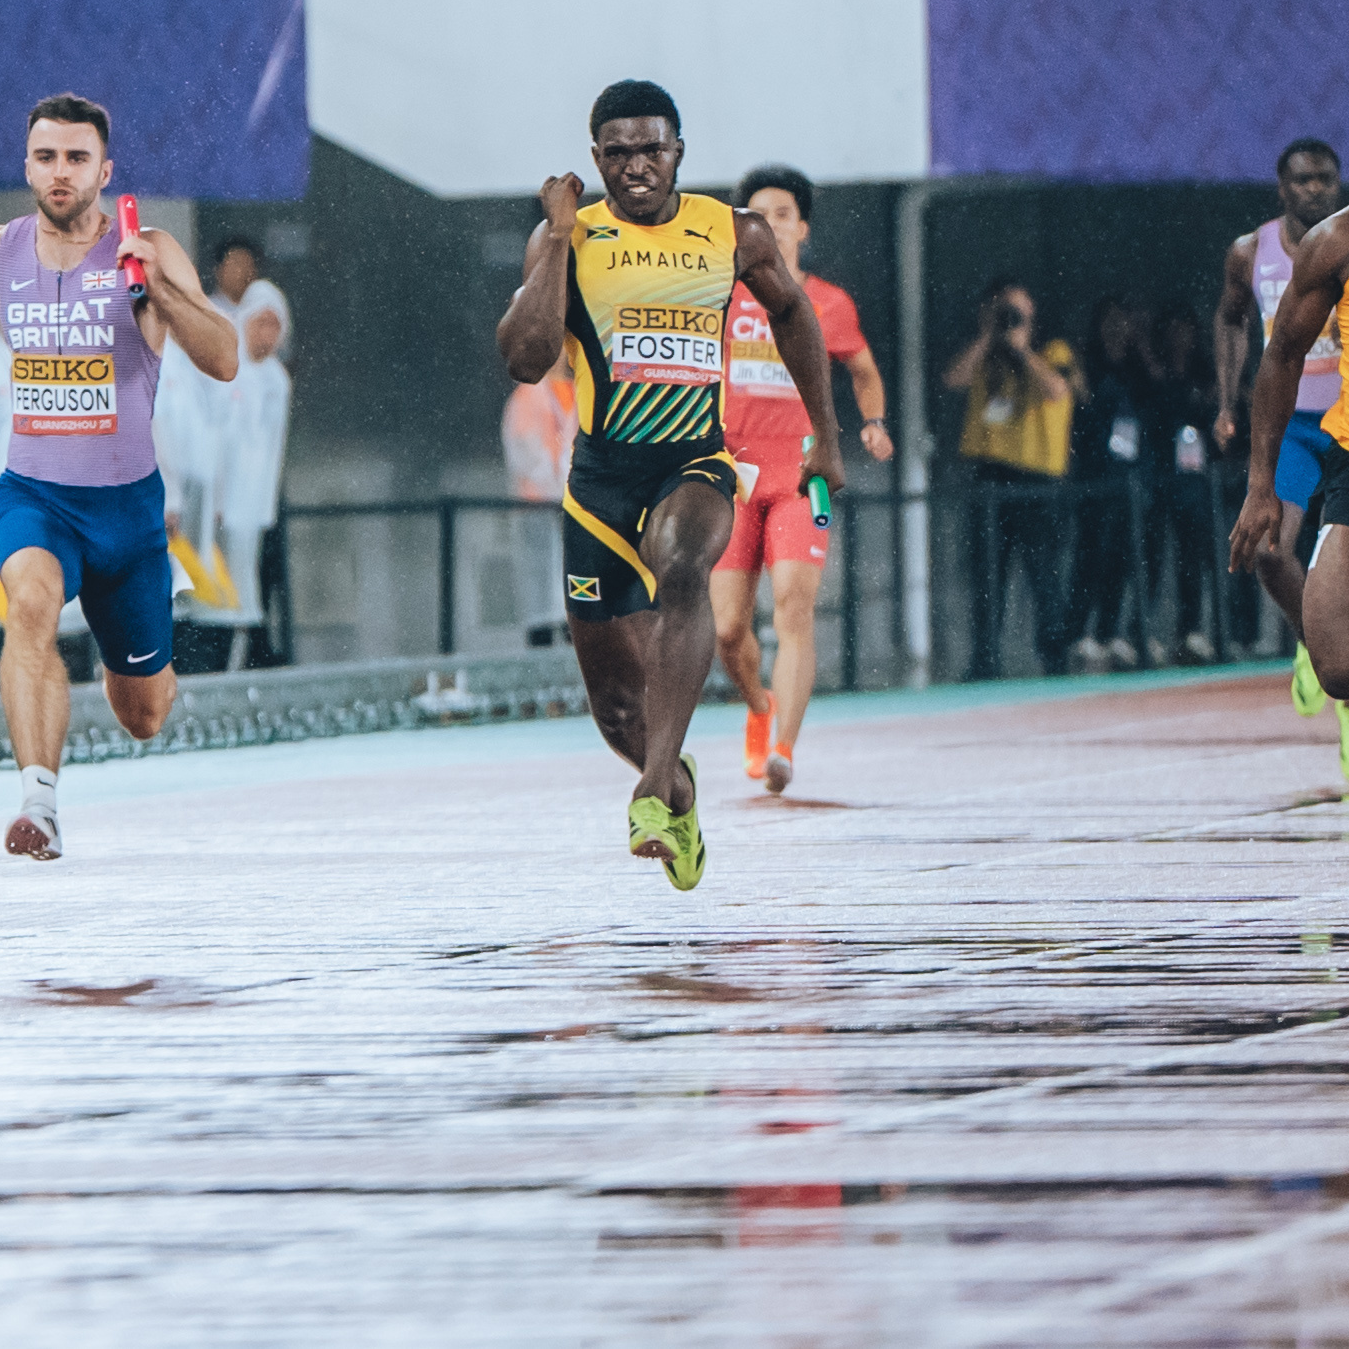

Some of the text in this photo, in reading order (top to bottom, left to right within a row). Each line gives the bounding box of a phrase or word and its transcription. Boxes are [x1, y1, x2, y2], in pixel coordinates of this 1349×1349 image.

[607, 250, 709, 272] JAMAICA
[7, 298, 111, 324] GREAT
[619, 308, 720, 335] SEIKO
[8, 325, 114, 349] BRITAIN
[622, 336, 716, 365] FOSTER
[15, 358, 109, 380] SEIKO
[644, 368, 707, 382] GUANGZHOU
[16, 387, 110, 411] FERGUSON
[32, 419, 112, 430] GUANGZHOU 25
